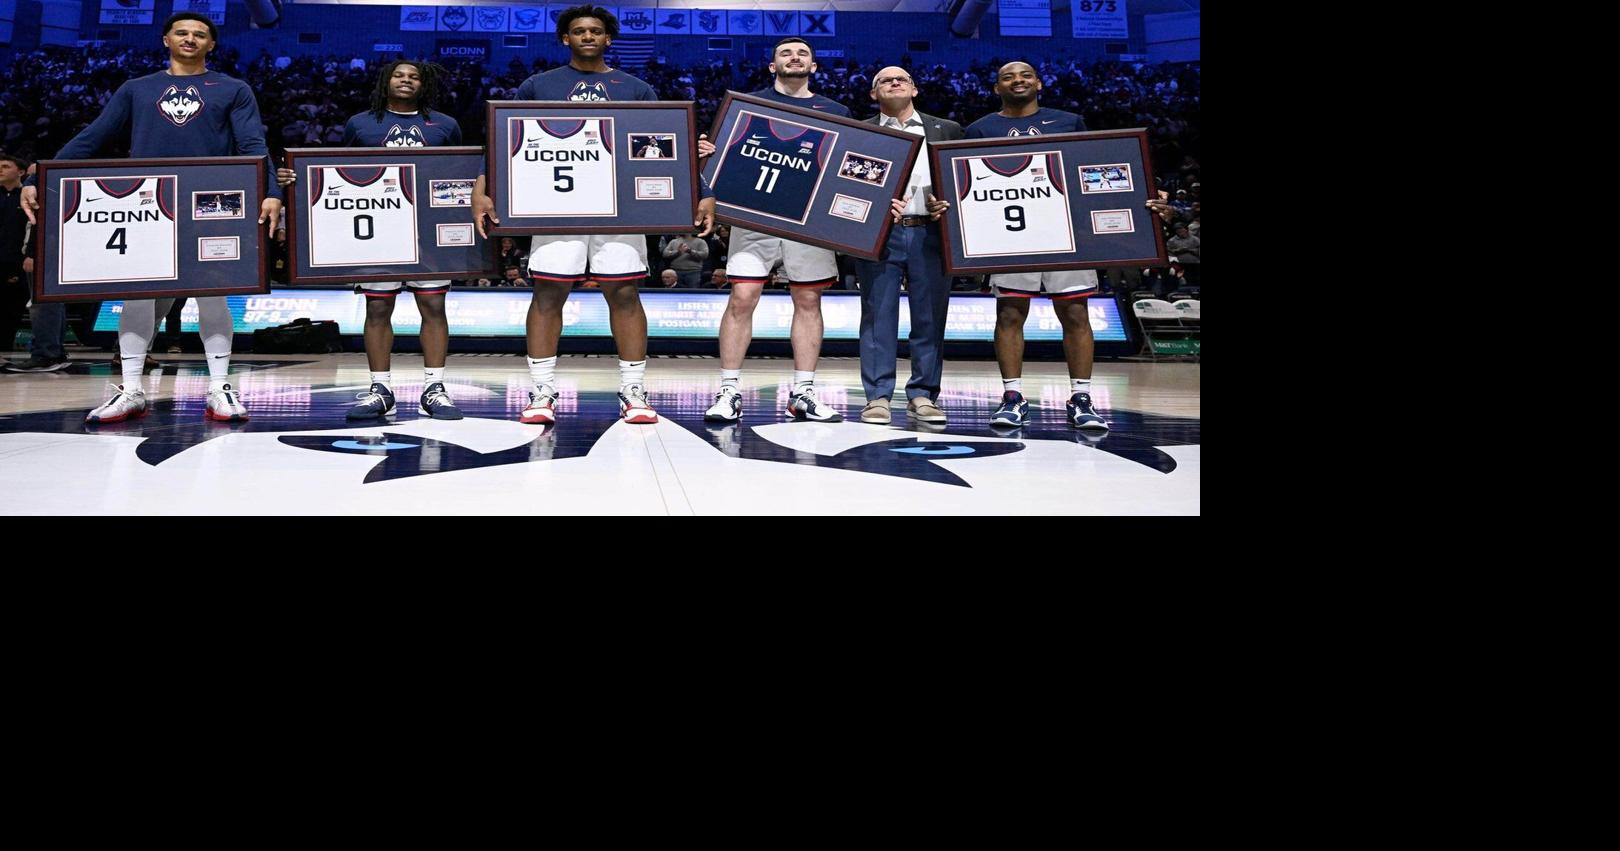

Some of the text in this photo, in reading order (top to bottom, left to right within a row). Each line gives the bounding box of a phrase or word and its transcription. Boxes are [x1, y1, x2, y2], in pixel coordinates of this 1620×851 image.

[1080, 0, 1117, 12] 873
[804, 13, 830, 34] X
[440, 47, 485, 55] UCONN
[525, 150, 600, 162] UCONN
[740, 144, 812, 172] UCONN
[554, 166, 574, 192] 5
[754, 165, 781, 194] 11
[973, 186, 1051, 201] UCONN
[325, 198, 401, 210] UCONN
[77, 209, 160, 223] UCONN
[1004, 205, 1026, 231] 9
[354, 214, 374, 240] 0
[105, 228, 127, 254] 4
[246, 298, 319, 311] UCONN
